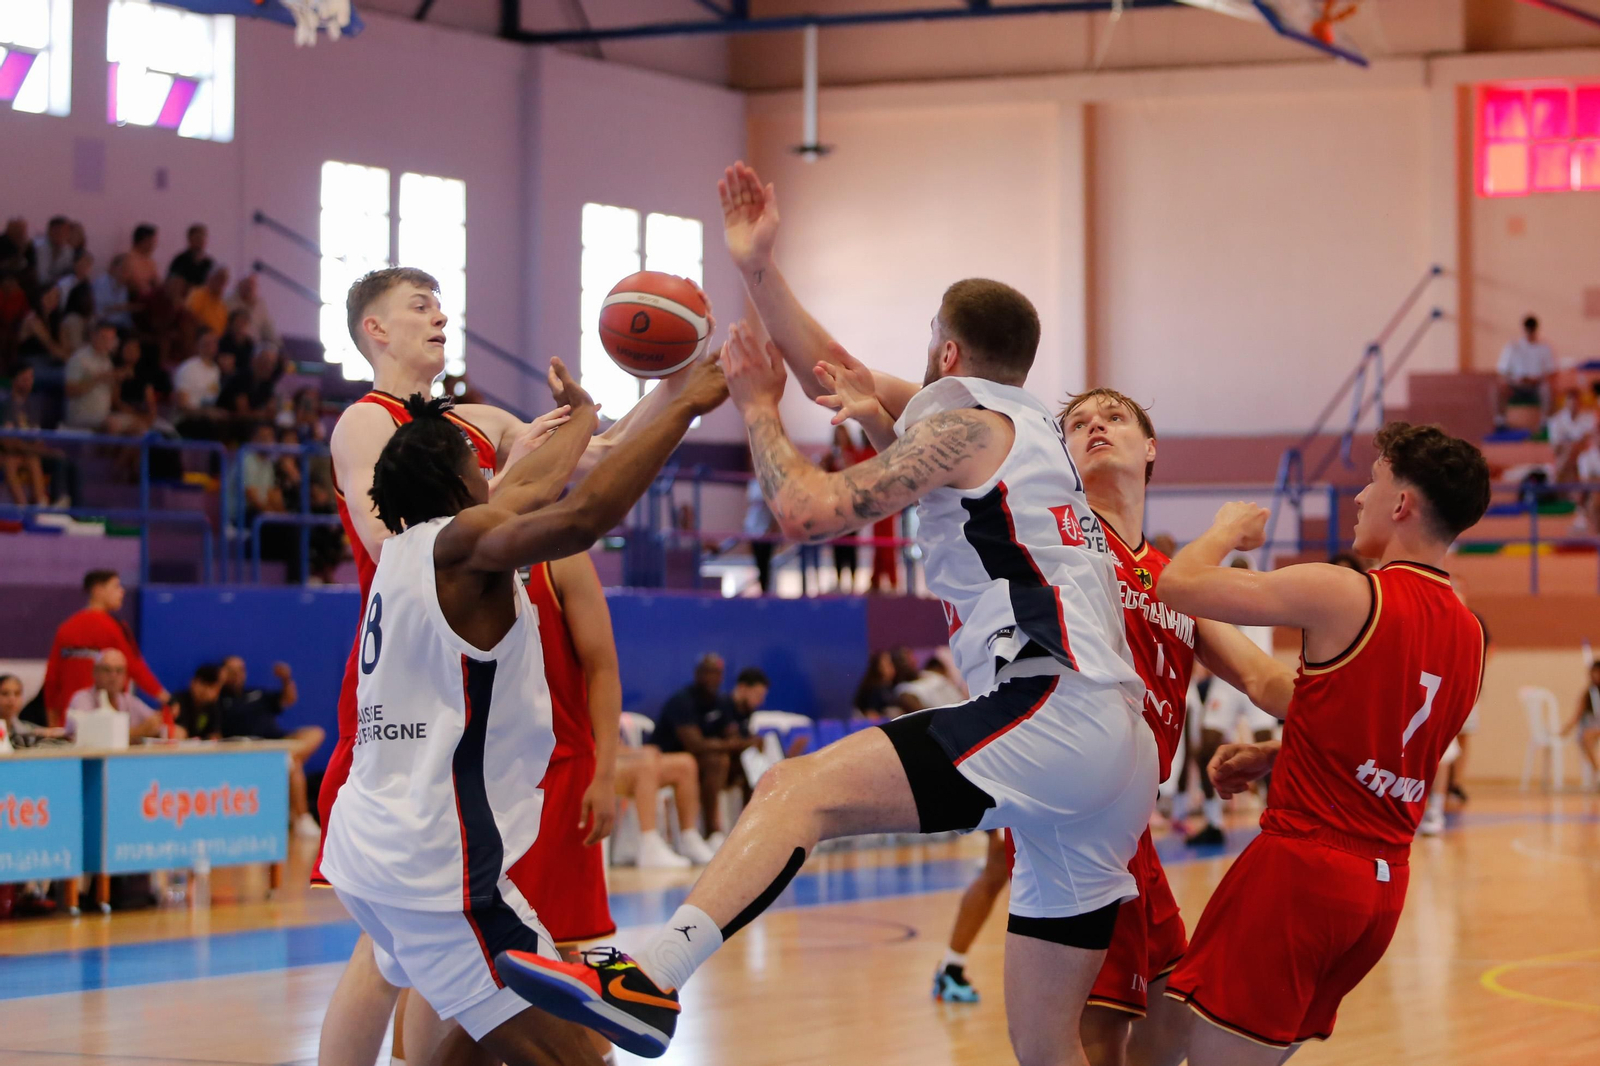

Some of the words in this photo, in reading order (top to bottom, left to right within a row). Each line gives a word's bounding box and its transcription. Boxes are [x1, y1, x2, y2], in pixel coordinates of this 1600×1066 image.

[1079, 516, 1103, 533] CA
[1401, 670, 1442, 758] 7
[141, 780, 260, 828] deportes
